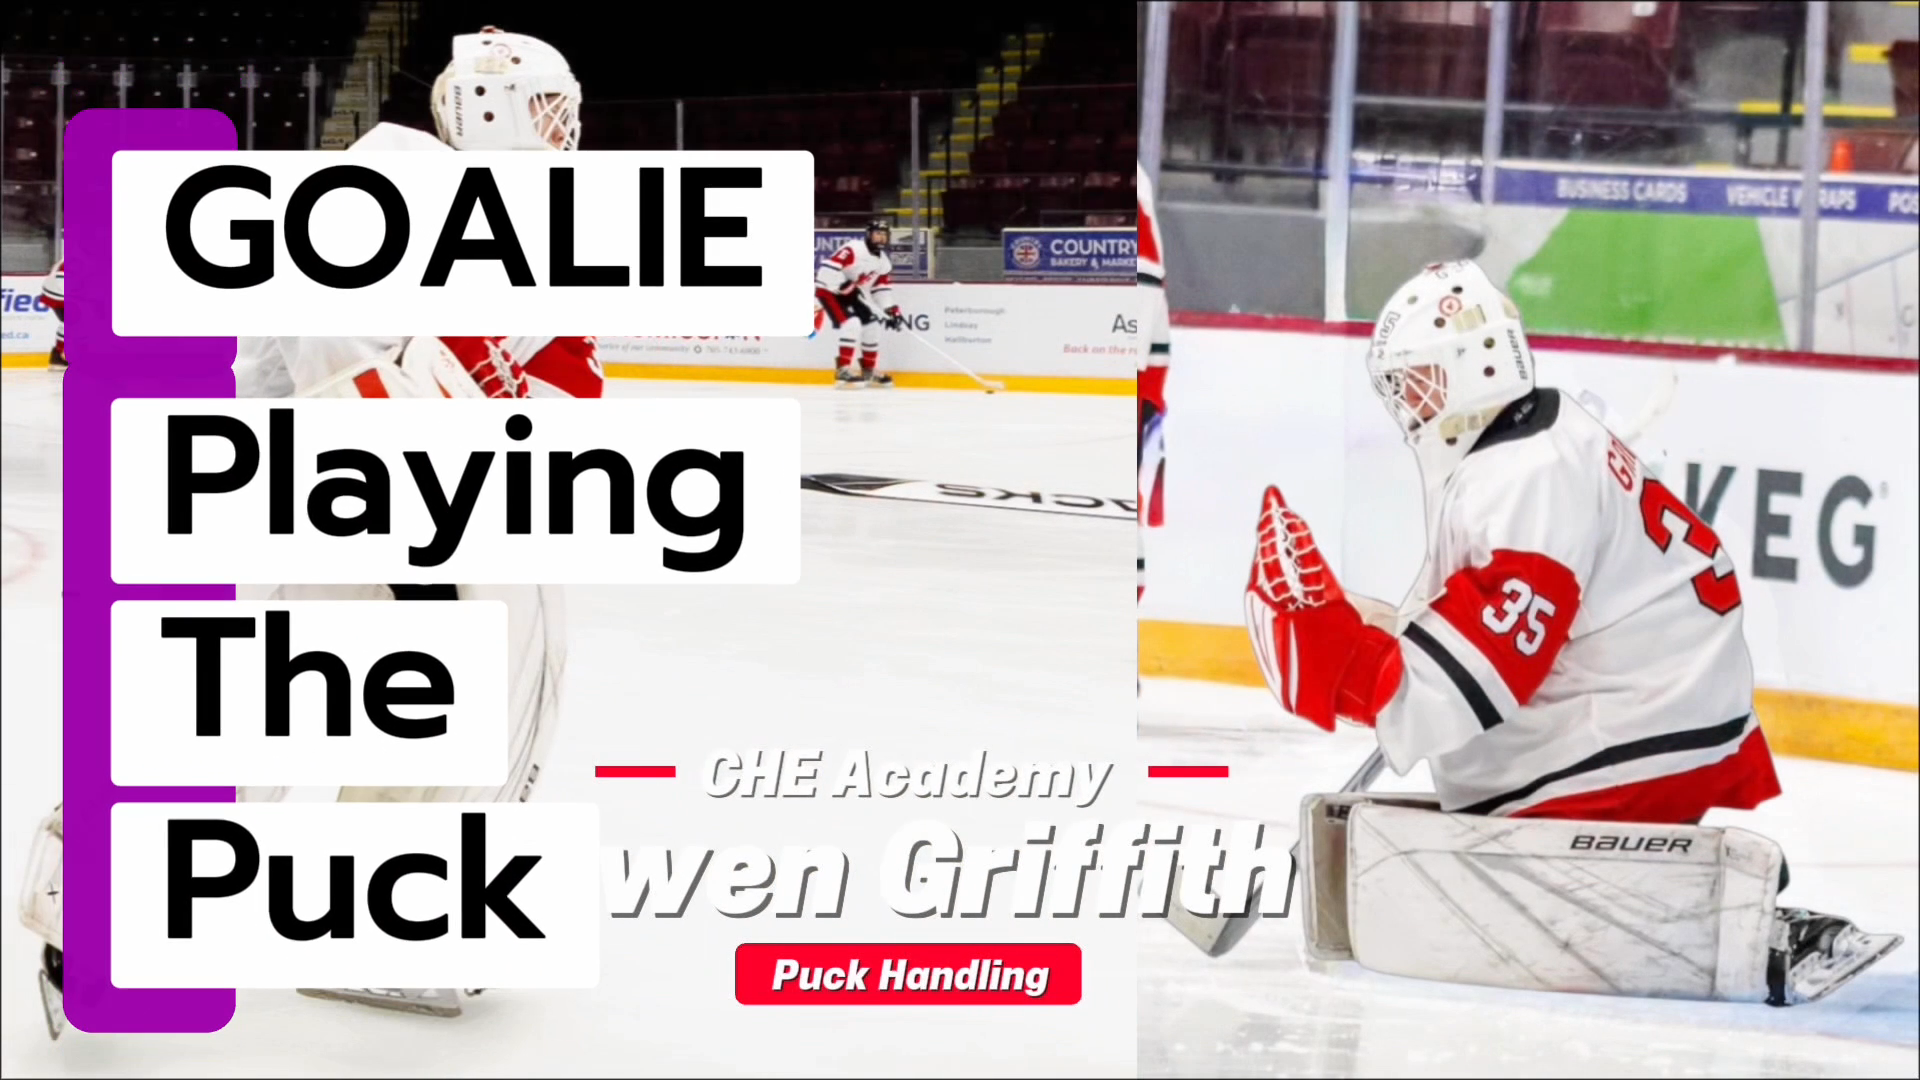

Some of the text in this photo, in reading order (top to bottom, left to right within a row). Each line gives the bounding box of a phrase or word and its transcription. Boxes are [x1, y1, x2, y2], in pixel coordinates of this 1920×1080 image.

[1557, 177, 1688, 204] BUSINESS CARDS
[1726, 184, 1789, 208] VEHICLE
[1050, 239, 1137, 255] COUNTRY
[1481, 577, 1557, 656] 35
